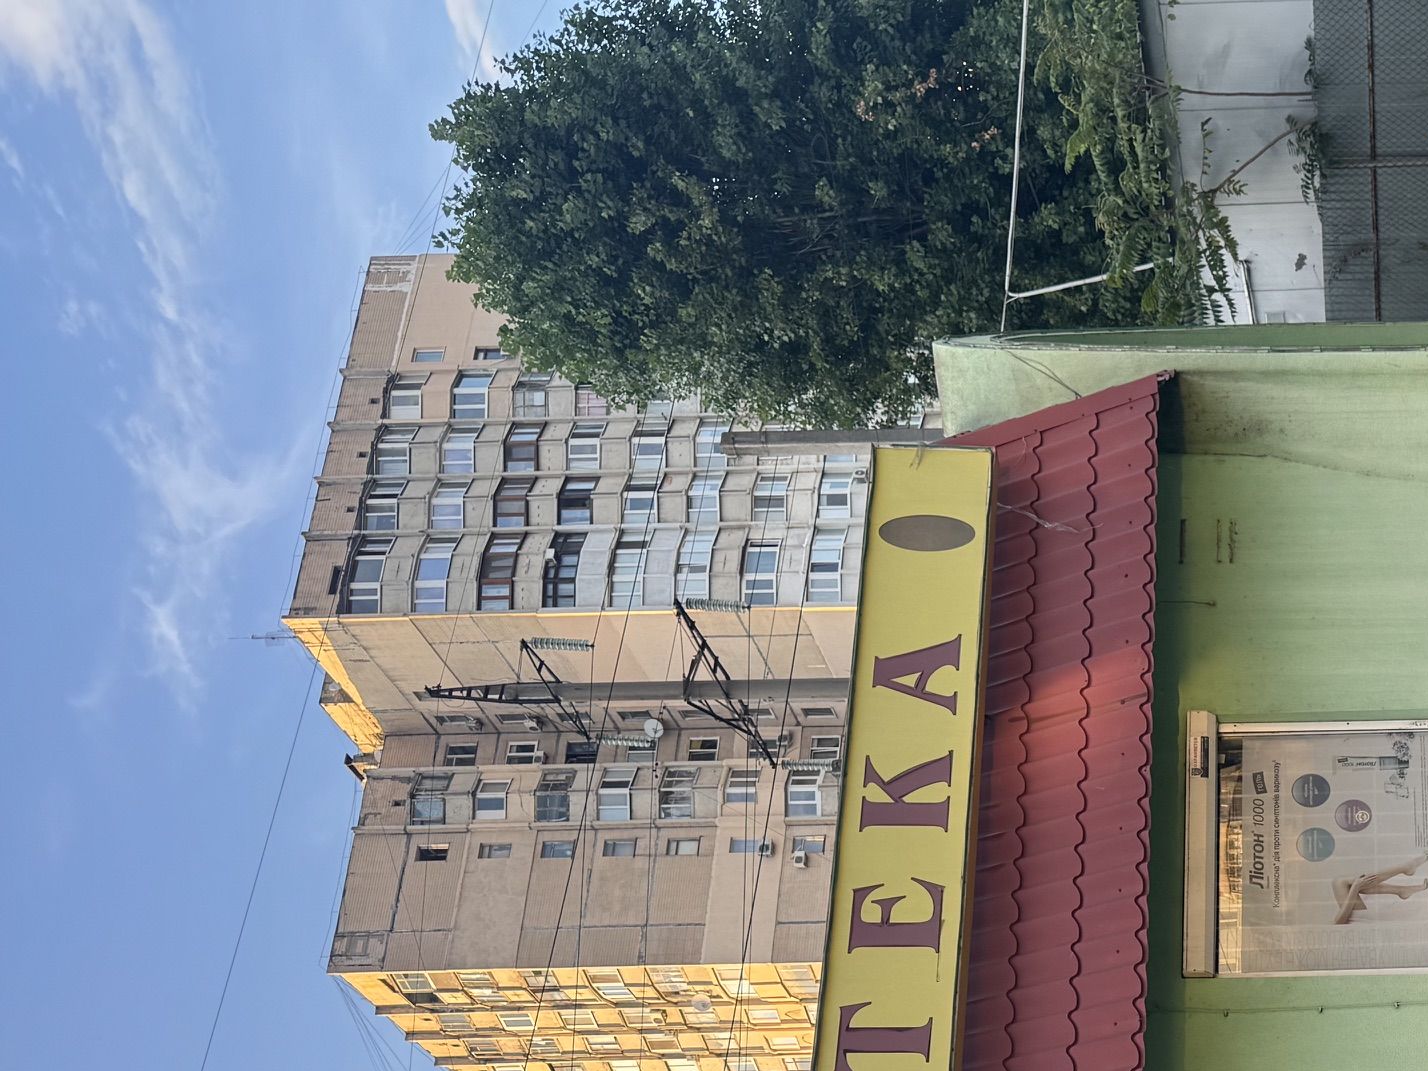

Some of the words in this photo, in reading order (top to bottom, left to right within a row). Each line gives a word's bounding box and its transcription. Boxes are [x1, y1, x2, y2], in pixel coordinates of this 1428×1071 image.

[1252, 798, 1264, 826] 1000
[1272, 793, 1281, 828] симптомів
[1273, 829, 1282, 850] проти
[1272, 850, 1282, 862] дія
